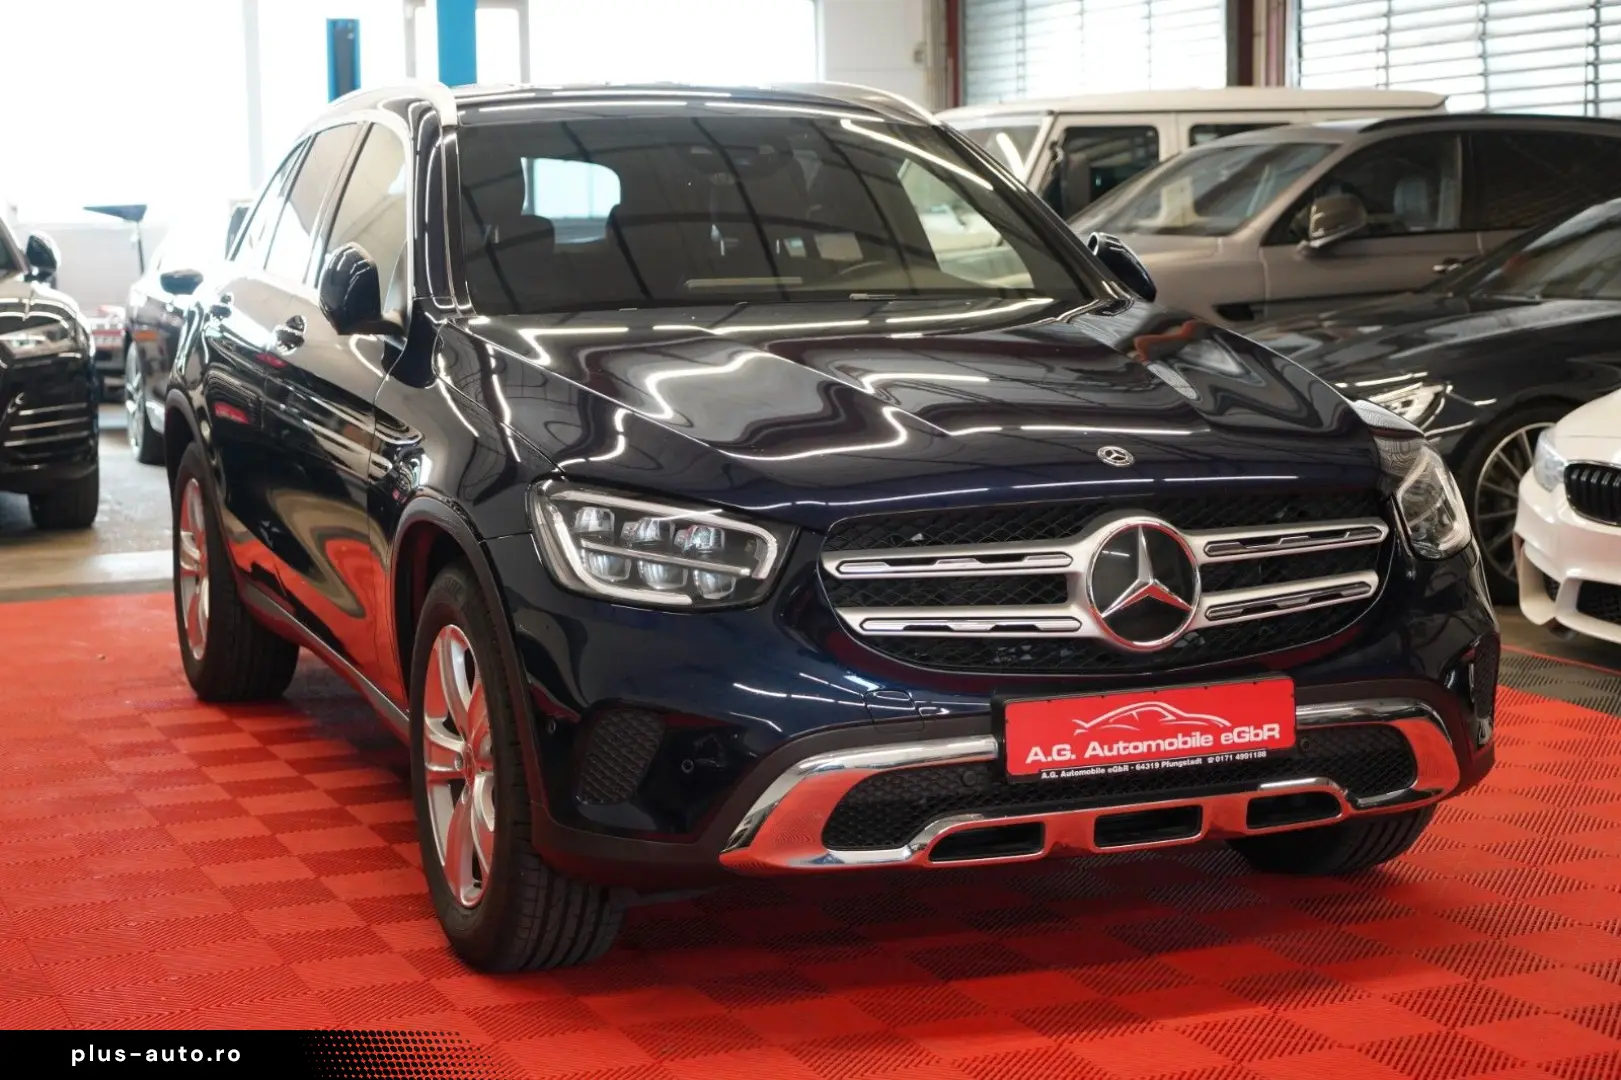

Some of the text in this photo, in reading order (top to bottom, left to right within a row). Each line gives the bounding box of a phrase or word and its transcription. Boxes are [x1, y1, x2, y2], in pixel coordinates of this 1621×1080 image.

[1025, 723, 1280, 764] A.G. Automobile eGbR
[1041, 771, 1059, 779] A.G.
[1060, 767, 1105, 778] Automobile
[1107, 764, 1129, 773] eGbR
[1135, 762, 1160, 770] 64319
[1161, 758, 1202, 768] Pfungstadt
[1215, 754, 1234, 763] 0171
